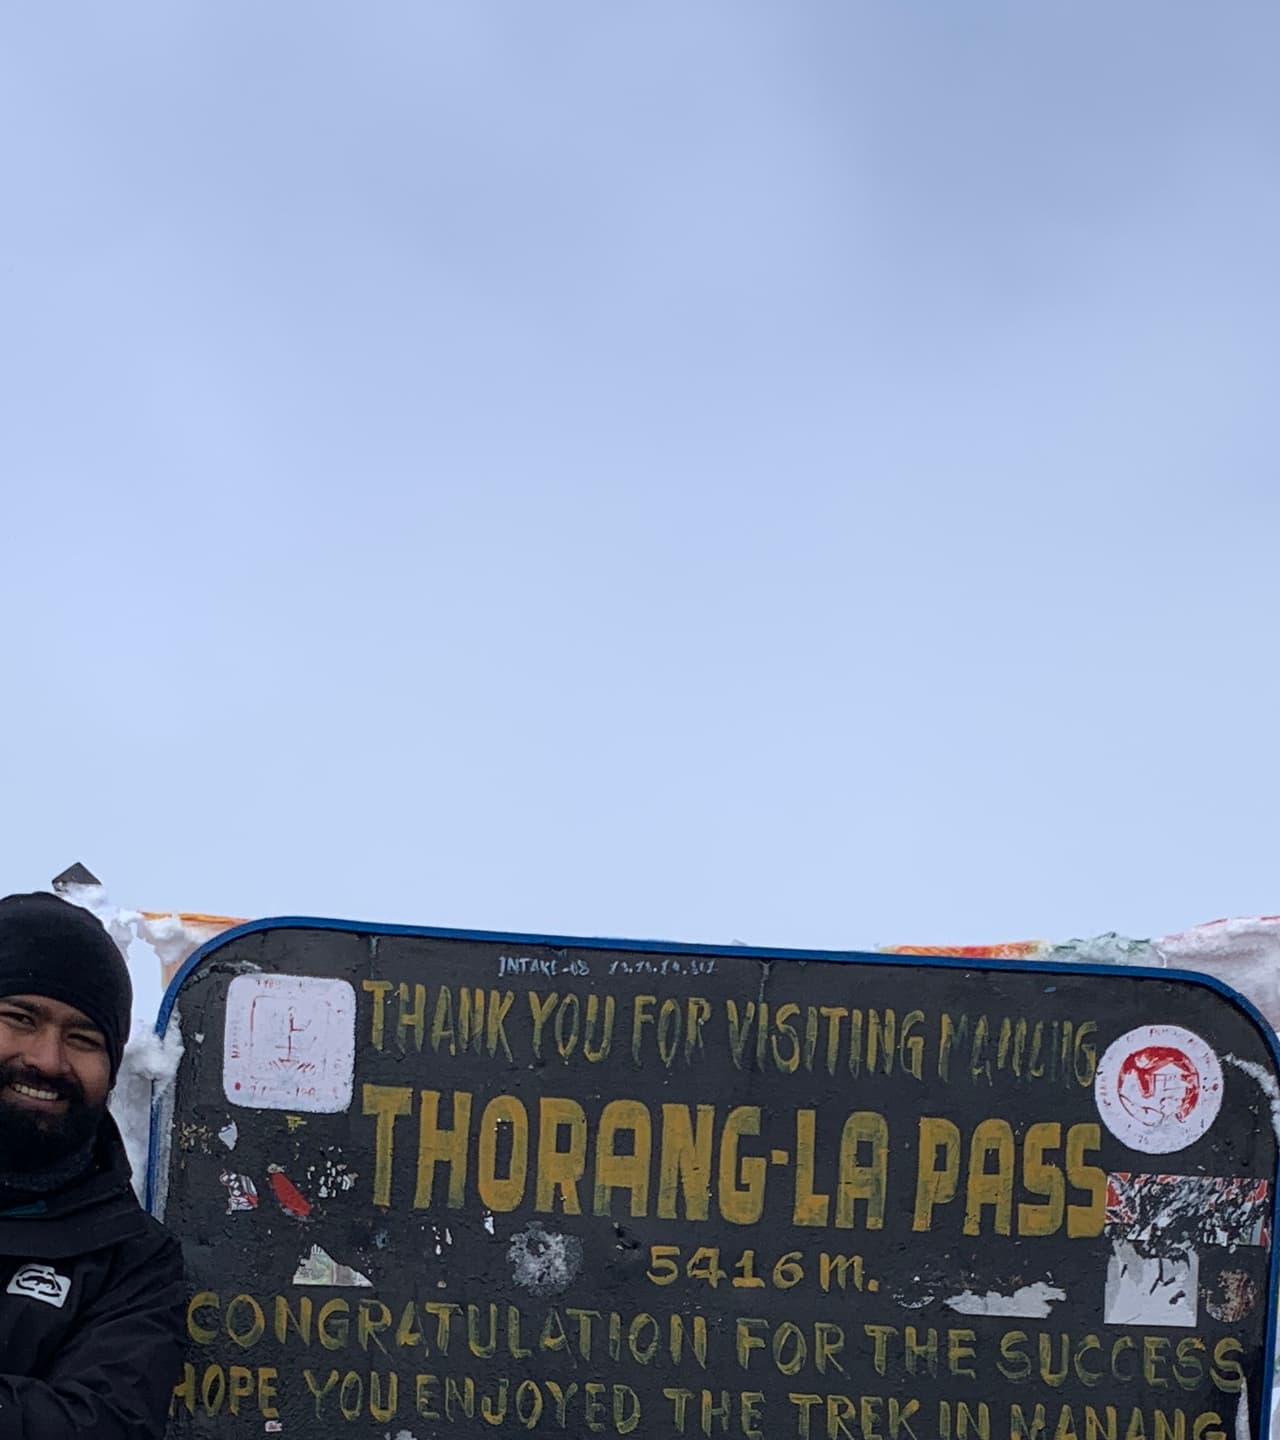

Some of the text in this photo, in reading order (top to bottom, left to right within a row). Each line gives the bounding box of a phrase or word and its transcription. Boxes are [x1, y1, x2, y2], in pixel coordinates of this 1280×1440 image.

[362, 980, 514, 1063] THANK
[529, 992, 615, 1064] YOU
[634, 995, 712, 1068] FOR
[727, 999, 925, 1082] VISITING
[362, 1084, 1107, 1239] THORANG-LA PASS
[646, 1246, 805, 1290] 5416
[186, 1290, 1246, 1396] CONGRATULATION FOR THE SUCCESS
[169, 1360, 280, 1418] HOPE
[303, 1368, 400, 1423] YOU
[416, 1372, 642, 1434] ENJOYED
[663, 1386, 766, 1440] THE
